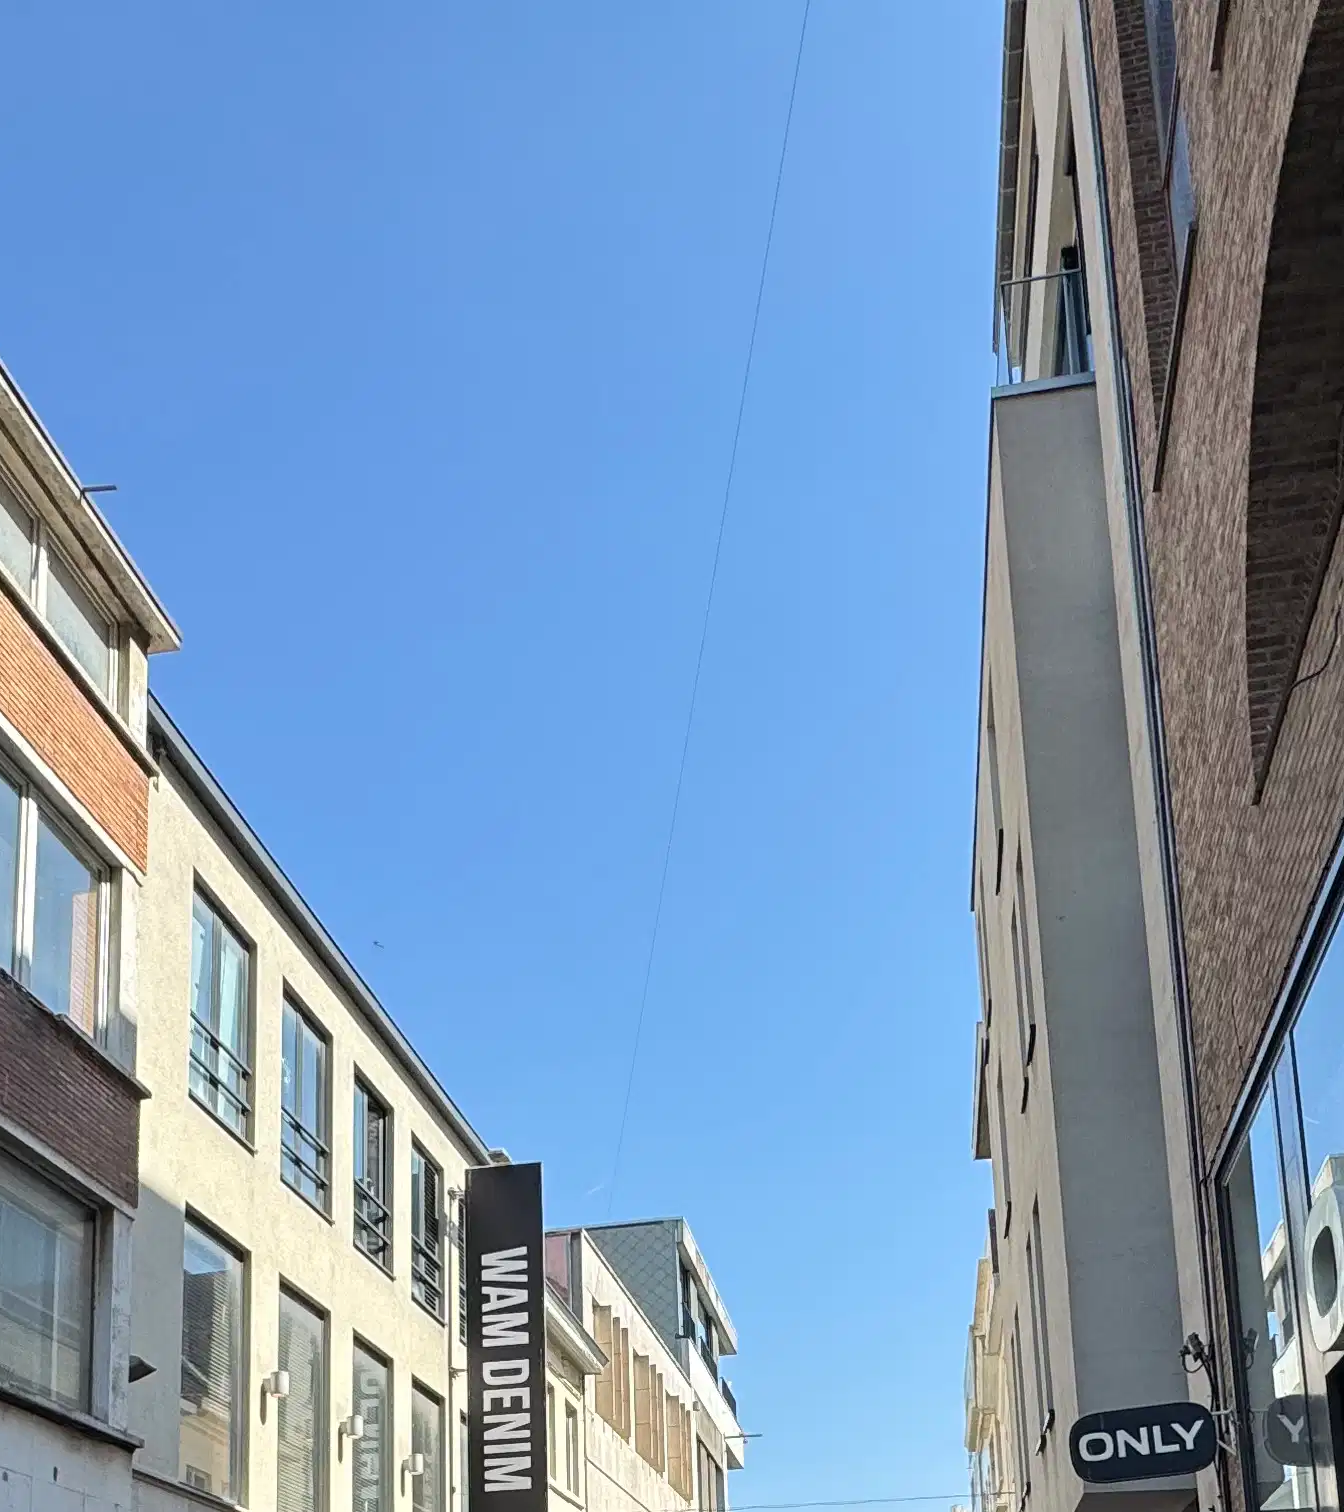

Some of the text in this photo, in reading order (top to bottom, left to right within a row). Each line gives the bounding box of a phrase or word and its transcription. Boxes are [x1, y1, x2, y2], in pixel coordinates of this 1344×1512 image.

[481, 1246, 532, 1492] WAM DENIM
[1078, 1419, 1204, 1462] ONLY
